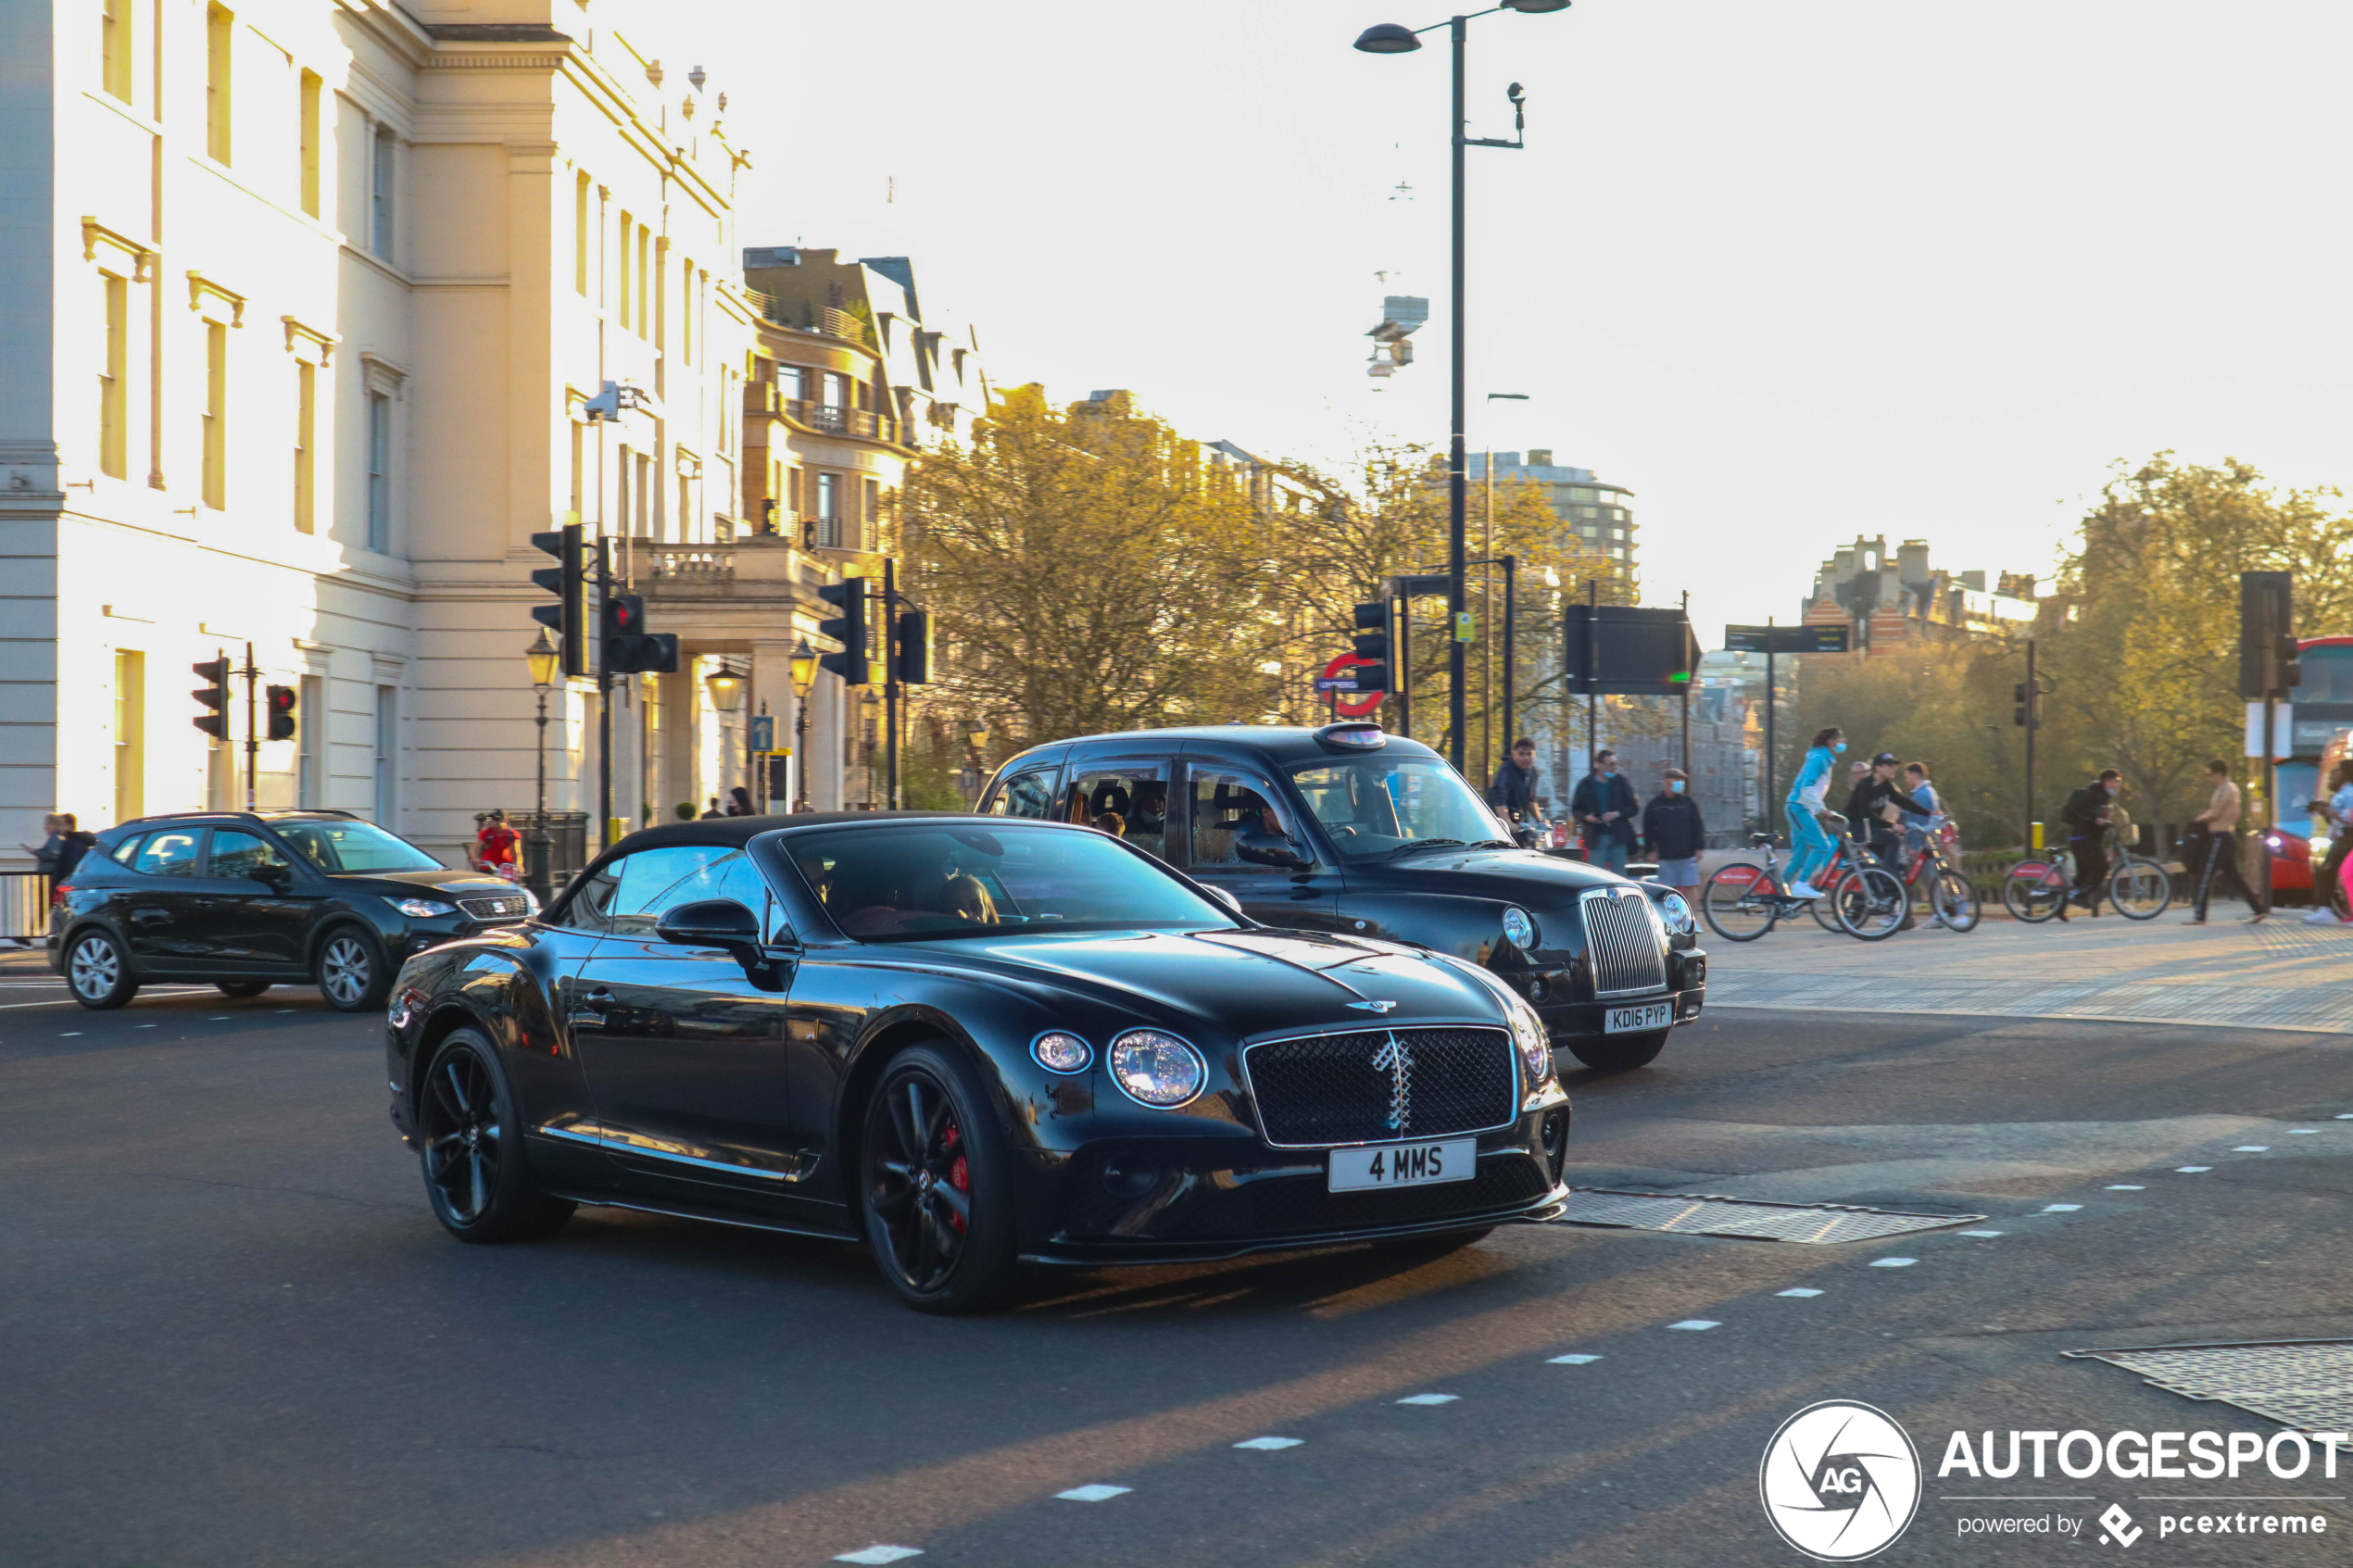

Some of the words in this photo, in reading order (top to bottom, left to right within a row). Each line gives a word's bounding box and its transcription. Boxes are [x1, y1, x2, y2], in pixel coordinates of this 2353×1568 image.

[1613, 1009, 1643, 1029] KD16
[1645, 1005, 1667, 1025] PYP
[1369, 1151, 1385, 1182] 4
[1393, 1146, 1442, 1181] MMS
